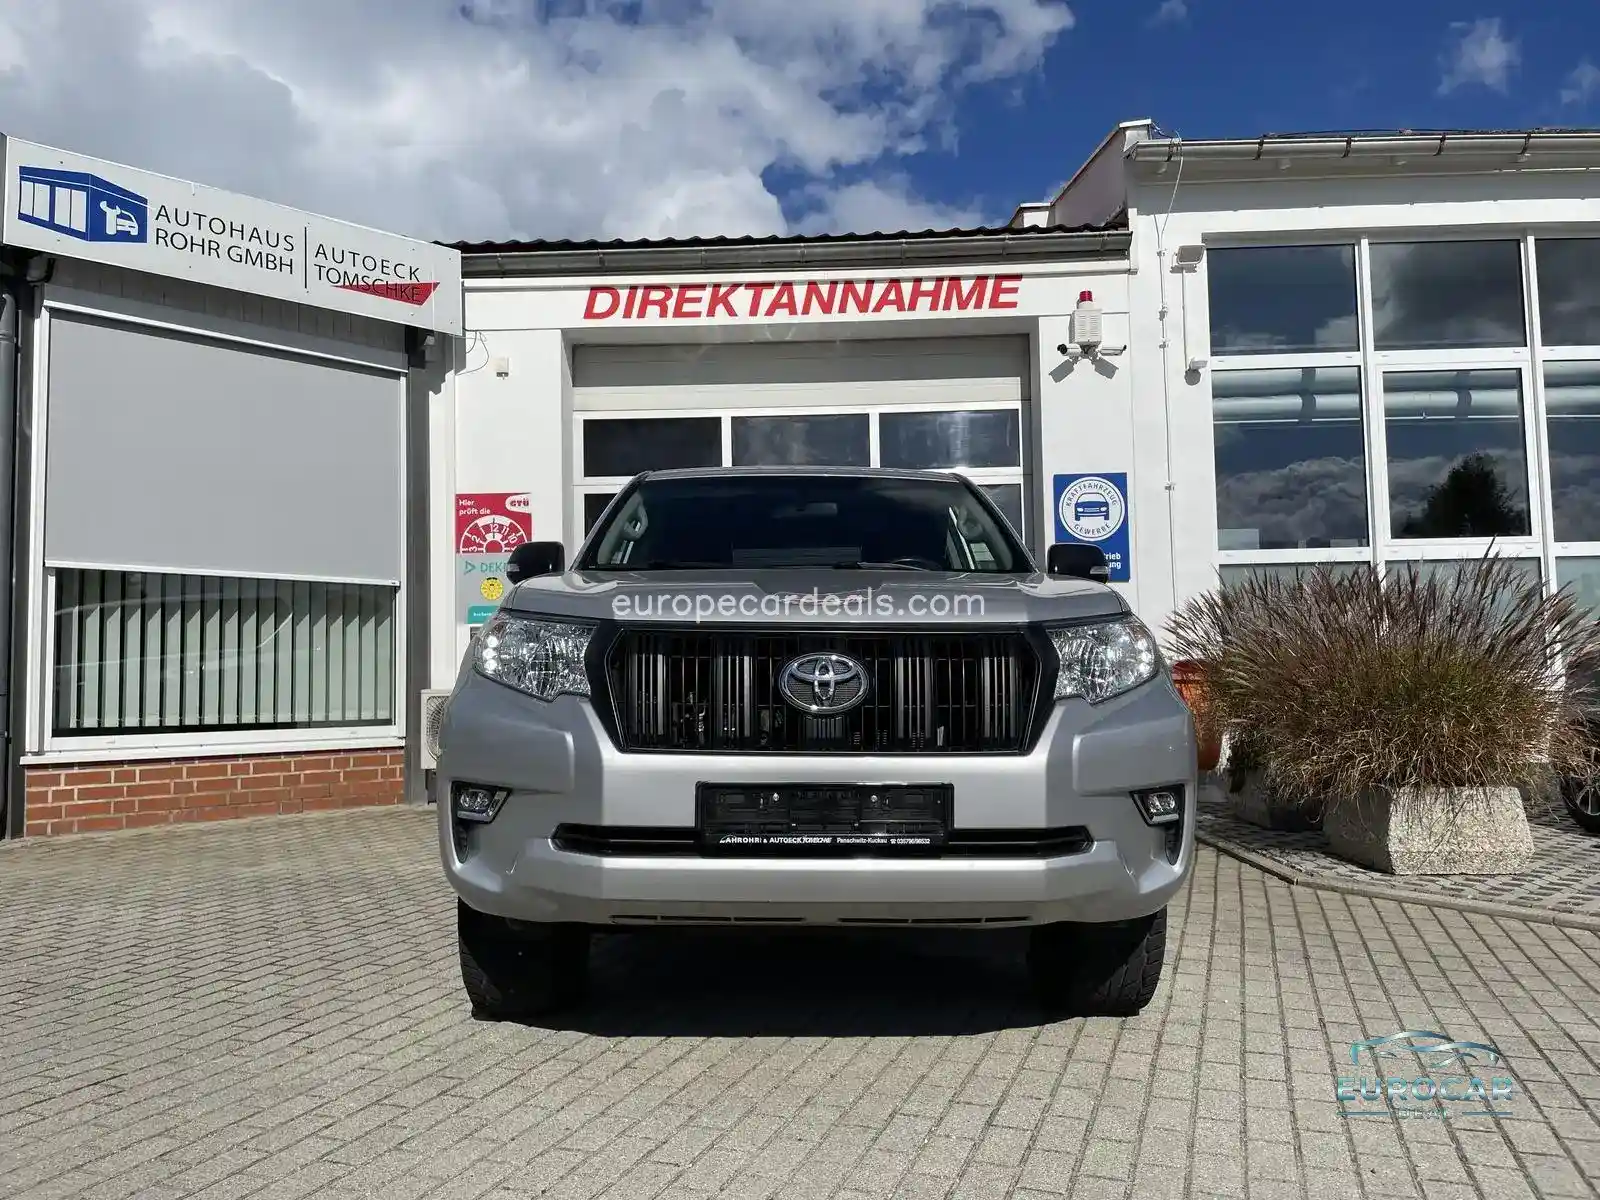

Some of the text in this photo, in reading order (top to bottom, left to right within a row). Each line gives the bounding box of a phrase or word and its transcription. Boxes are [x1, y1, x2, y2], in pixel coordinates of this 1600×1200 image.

[155, 205, 294, 251] AUTOHAUS
[156, 228, 293, 274] ROHR GMBH
[315, 243, 420, 282] AUTOECK
[314, 264, 420, 301] TOMSCHKE
[583, 274, 1022, 319] DIREKTANNAHME
[459, 507, 491, 516] prüft die
[1065, 482, 1118, 507] KRAFTFAHRZEUG
[490, 523, 499, 532] 12
[1074, 521, 1111, 535] GEWERBE
